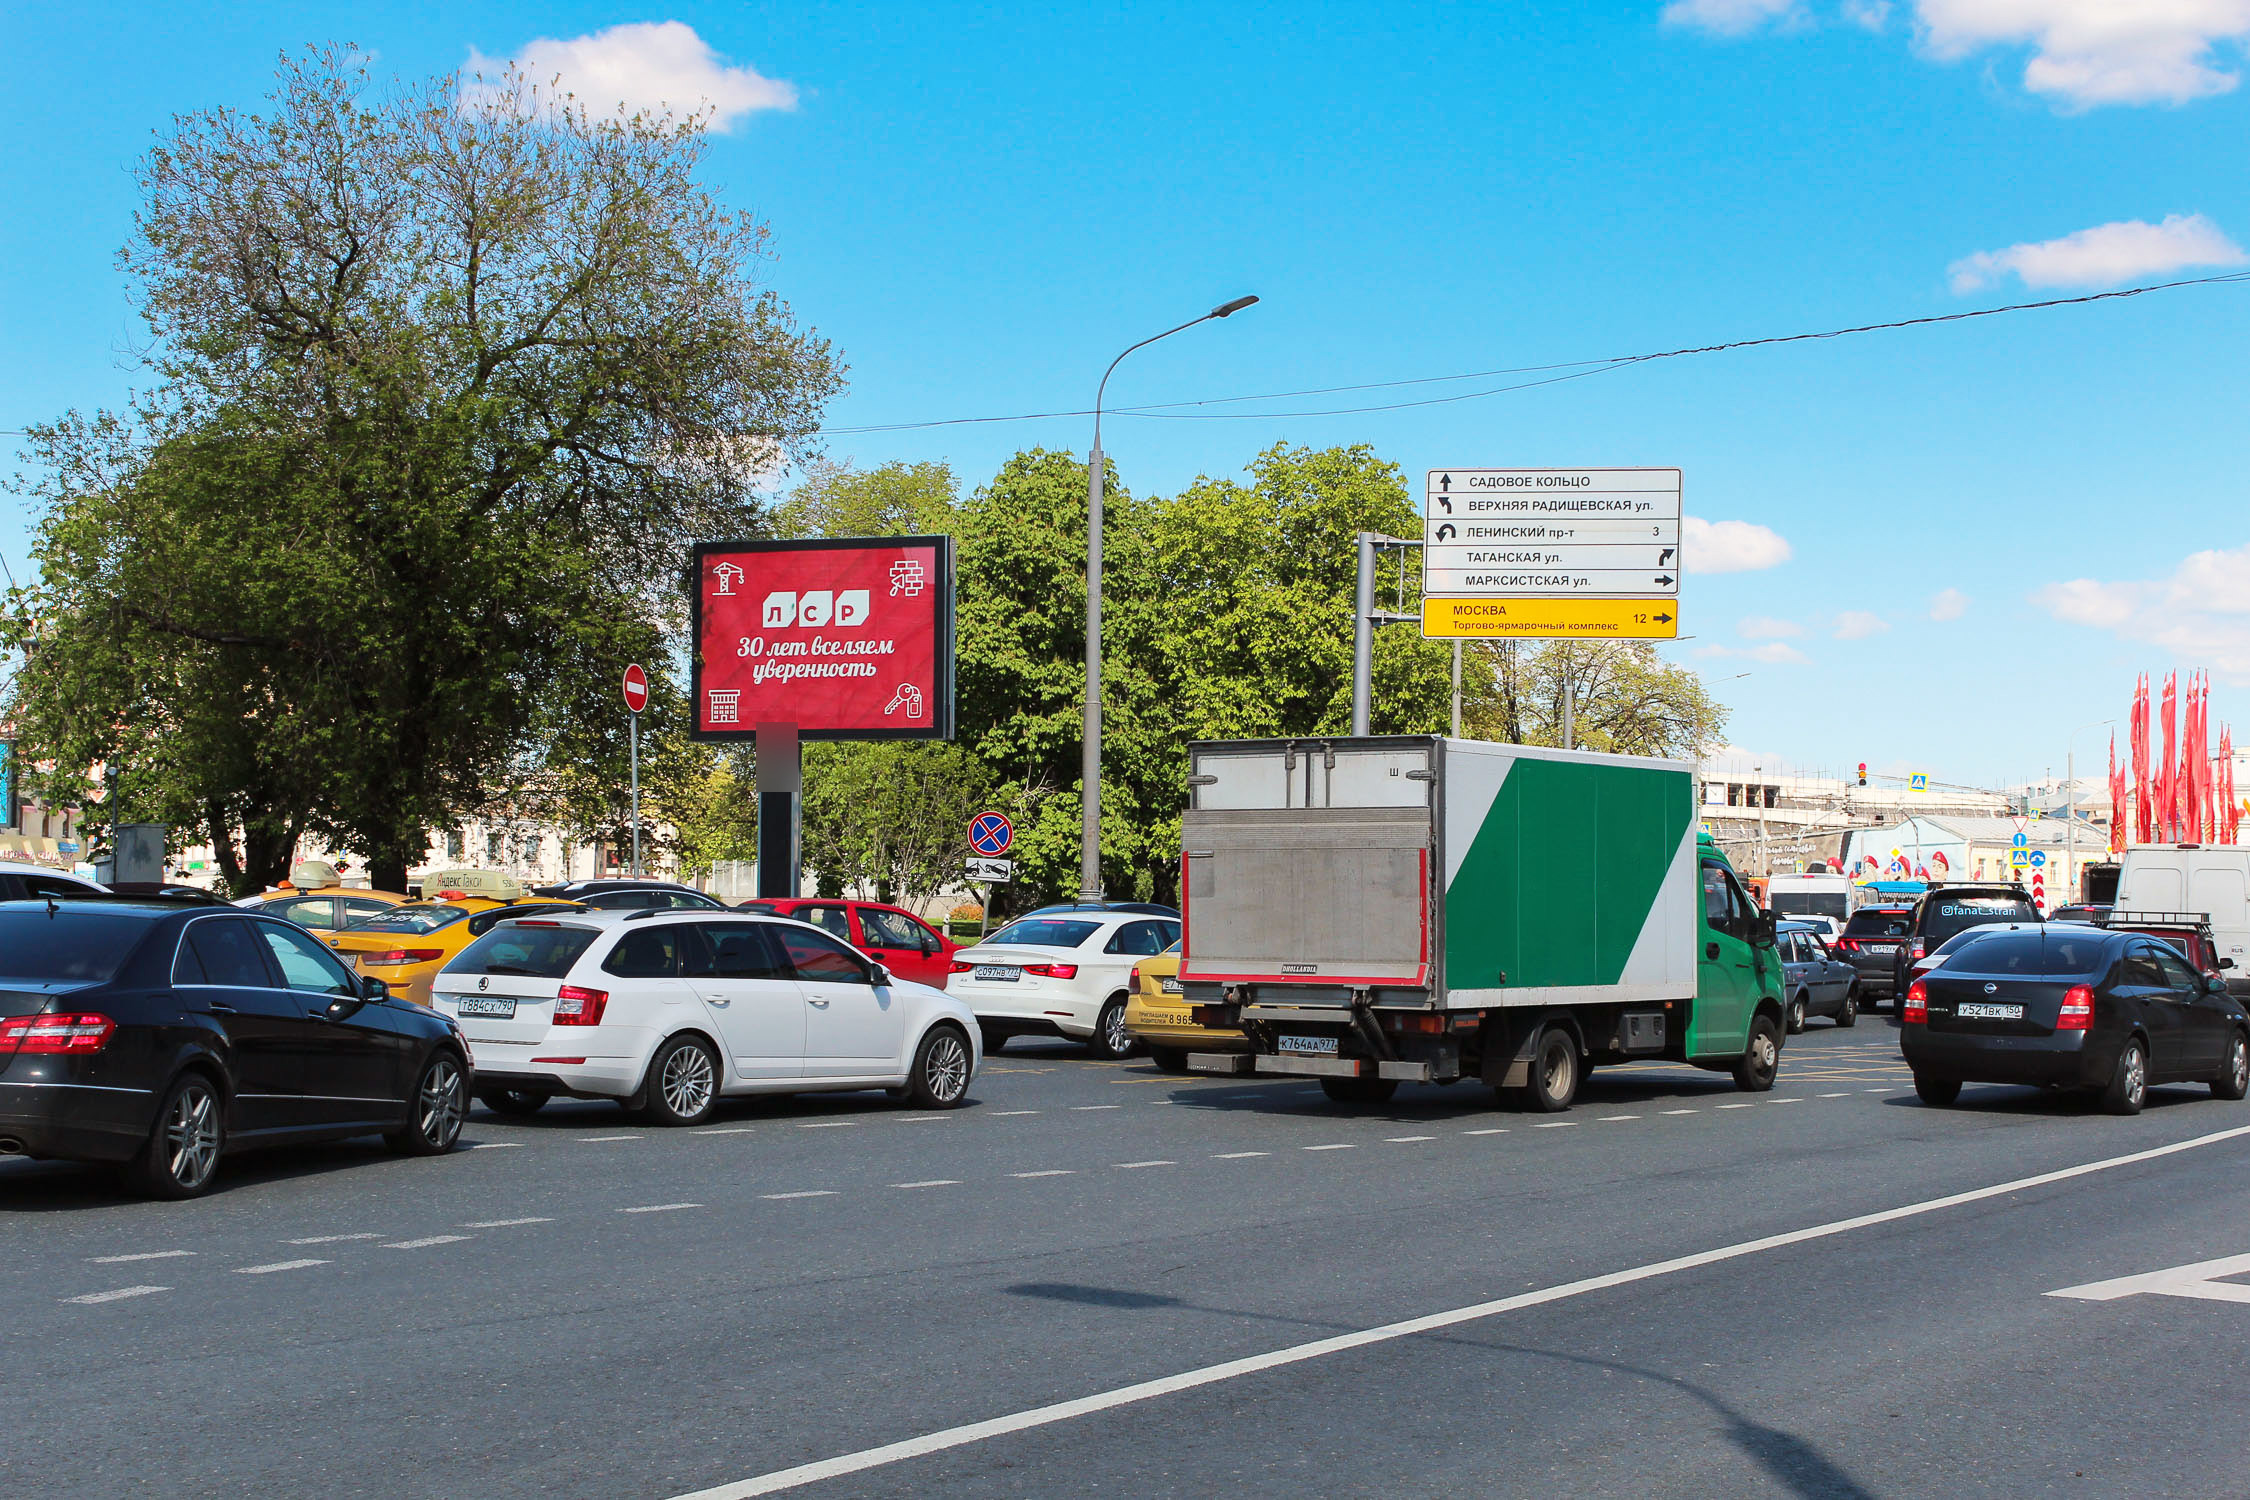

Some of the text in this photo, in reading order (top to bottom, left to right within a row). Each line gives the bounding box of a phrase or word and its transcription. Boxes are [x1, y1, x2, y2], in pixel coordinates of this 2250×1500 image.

[1469, 476, 1591, 488] САДОВОЕ КОЛЬЦО
[1468, 500, 1654, 514] ВЕРХНЯЯ РАДИЩЕВСКАЯ ул.
[1466, 525, 1575, 541] ЛЕНИНСКИЙ пр-т
[1652, 526, 1660, 537] 3
[1467, 552, 1563, 565] ТАГАНСКАЯ ул.
[1465, 575, 1592, 588] МАРКСИСТСКАЯ ул.
[1453, 605, 1507, 616] МОСКВА
[1633, 613, 1647, 624] 12
[1453, 620, 1619, 632] Торгово-ярмарочный комплекс
[736, 636, 894, 657] 30 лет вселяем
[752, 659, 877, 685] уверенность
[437, 873, 483, 888] Яндекс Такси
[1282, 965, 1317, 973] DHOLLANDIA
[1962, 1003, 2001, 1017] У521ВК
[2004, 1005, 2019, 1015] 150
[1169, 1014, 1174, 1025] 8
[1281, 1037, 1336, 1051] К764АА 977
